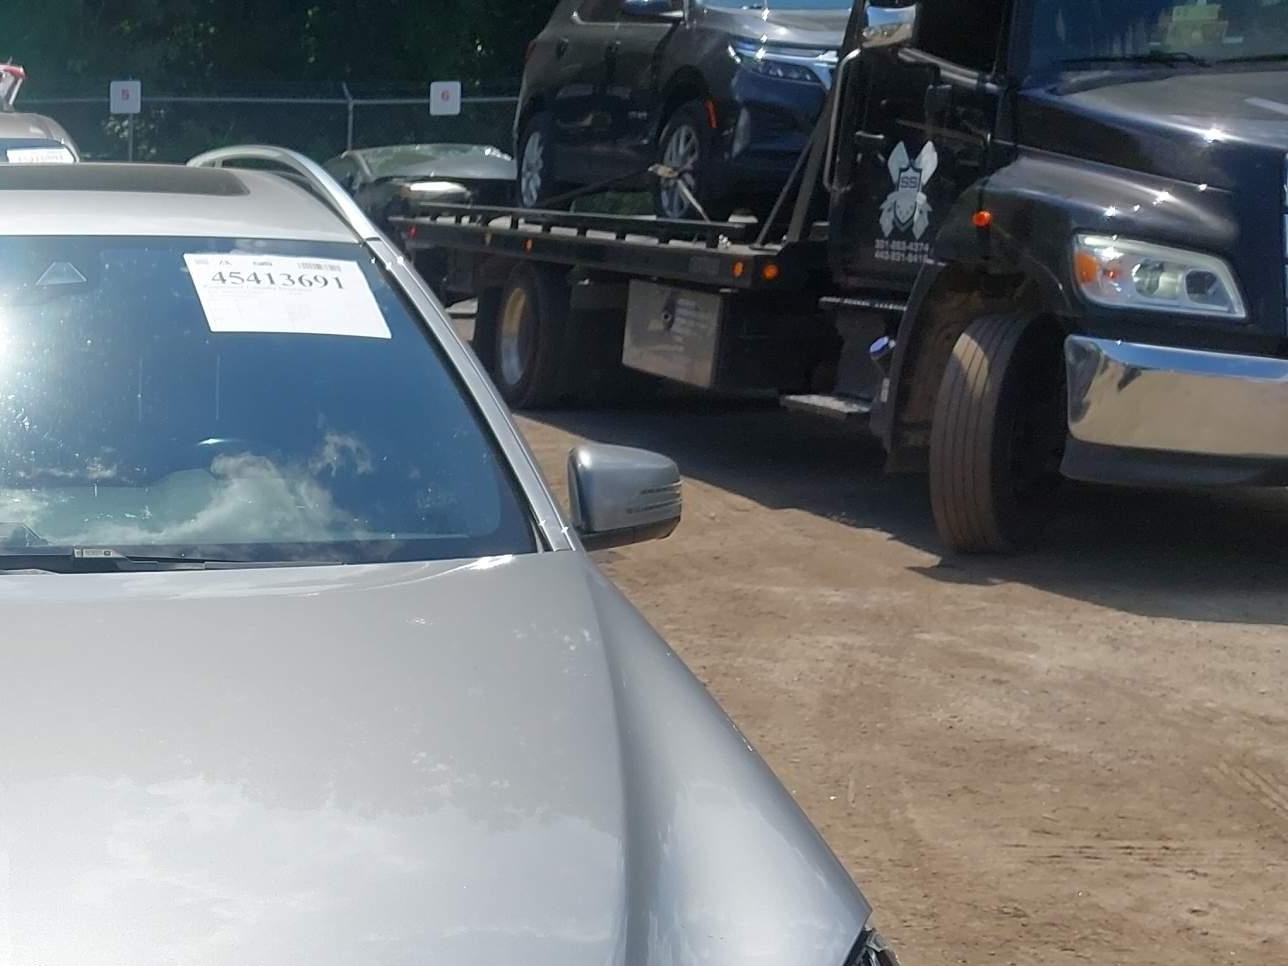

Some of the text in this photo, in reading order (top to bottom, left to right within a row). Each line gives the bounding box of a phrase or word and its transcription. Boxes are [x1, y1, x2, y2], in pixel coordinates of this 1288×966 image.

[120, 88, 130, 101] 5
[440, 89, 450, 102] 6
[211, 271, 344, 290] 45413691
